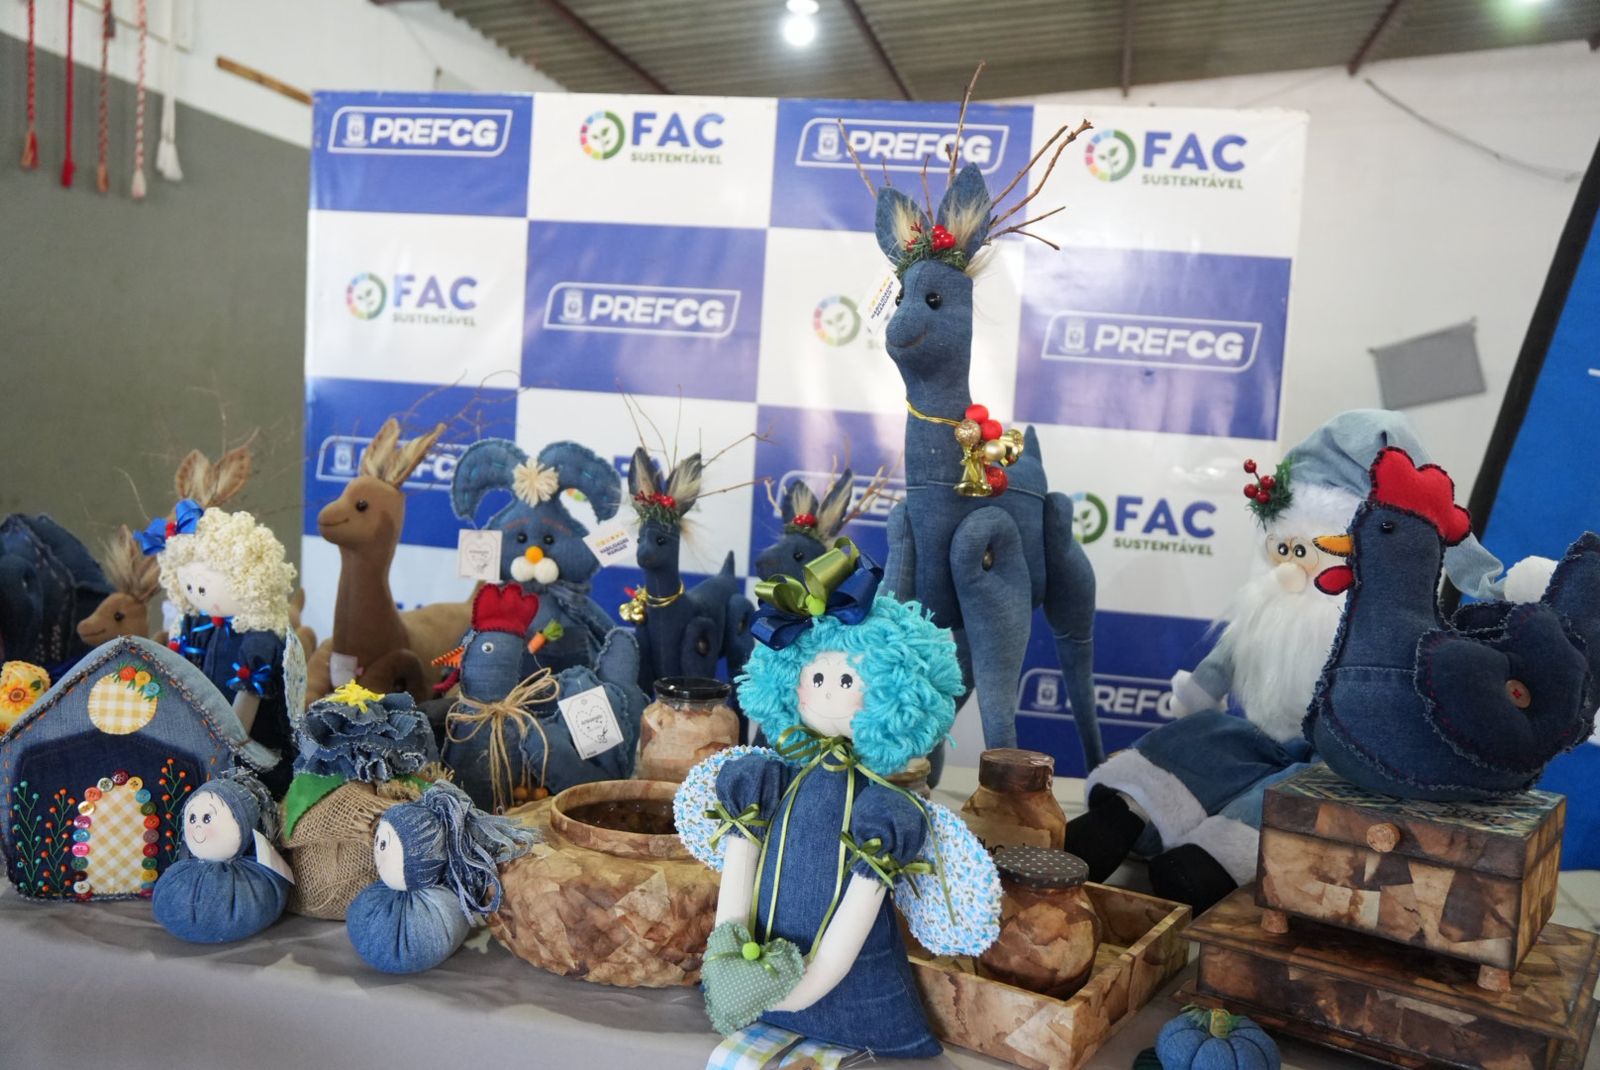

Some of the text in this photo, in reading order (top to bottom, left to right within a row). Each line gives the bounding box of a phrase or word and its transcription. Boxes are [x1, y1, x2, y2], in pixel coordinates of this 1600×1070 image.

[370, 117, 498, 147] PREFCG
[631, 112, 725, 149] FAC
[846, 130, 992, 164] PREFCG
[631, 150, 723, 165] SUSTENTÁVEL
[1142, 131, 1247, 172] FAC
[1141, 173, 1244, 190] SUSTENTÁVEL
[393, 274, 477, 310] FAC
[589, 293, 725, 327] PREFCG
[1094, 324, 1244, 361] PREFCG
[1114, 495, 1217, 538] FAC
[1113, 536, 1213, 556] SUSTENTÁVEL
